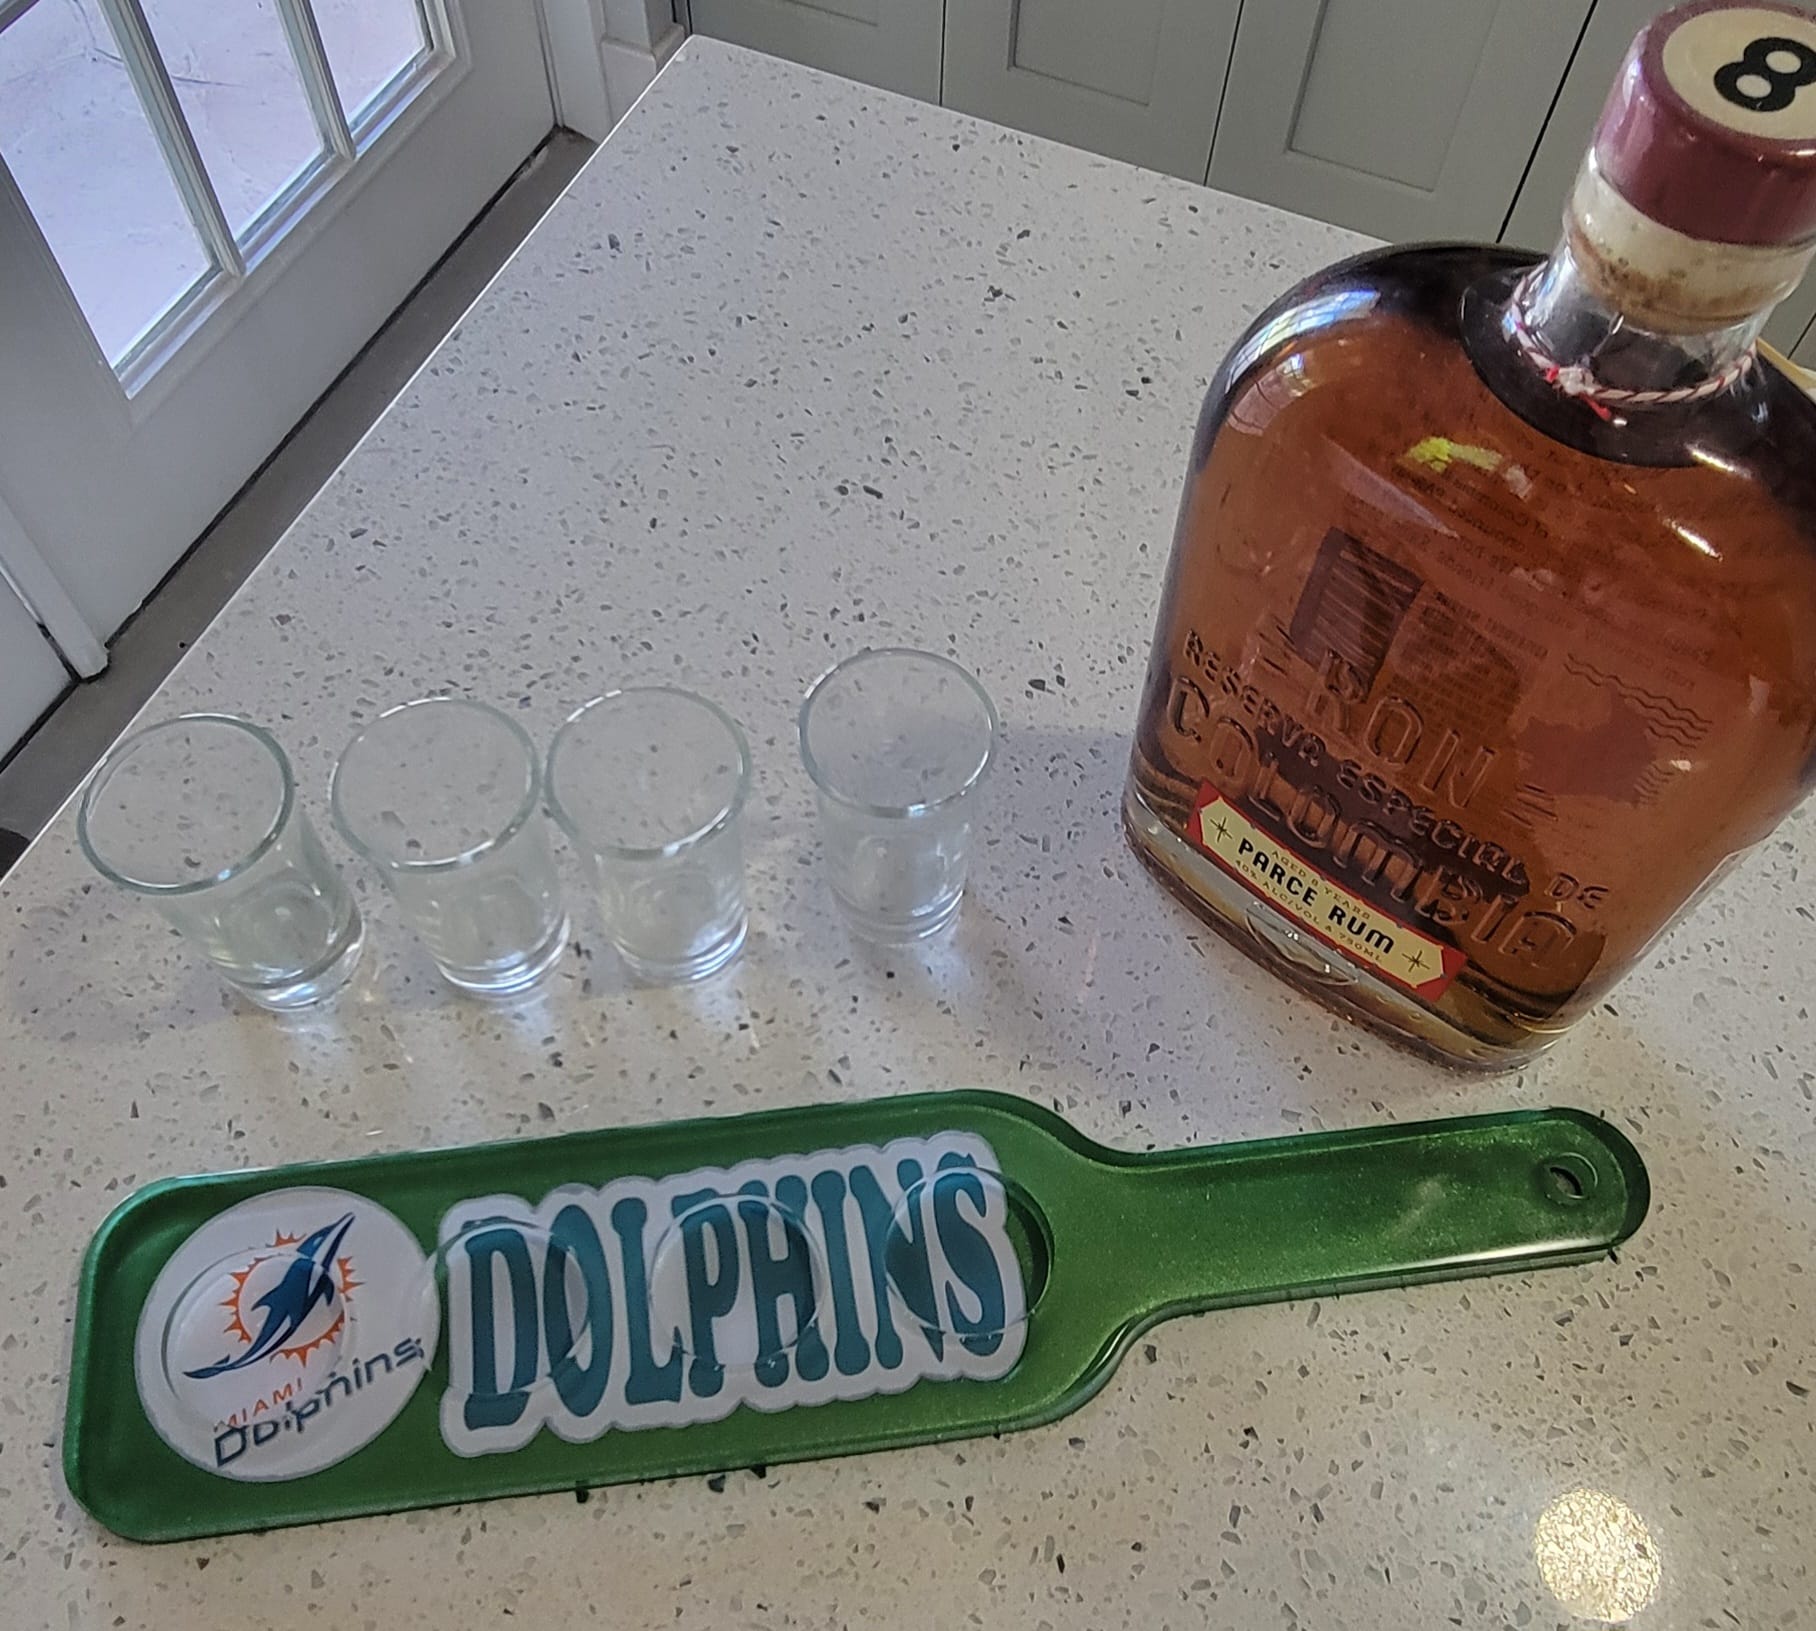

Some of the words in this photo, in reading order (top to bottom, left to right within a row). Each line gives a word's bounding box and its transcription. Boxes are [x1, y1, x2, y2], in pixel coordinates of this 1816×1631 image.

[1714, 37, 1816, 112] 8
[1306, 650, 1495, 808] RON
[1271, 850, 1308, 884] AGED
[1324, 887, 1372, 920] YEARS
[1336, 759, 1529, 884] ESPECIAL
[1544, 872, 1609, 909] DE
[1238, 838, 1319, 907] PARCE
[1328, 904, 1395, 954] RUM
[464, 1150, 1007, 1431] DOLPHINS
[213, 1377, 304, 1433] MIAMI
